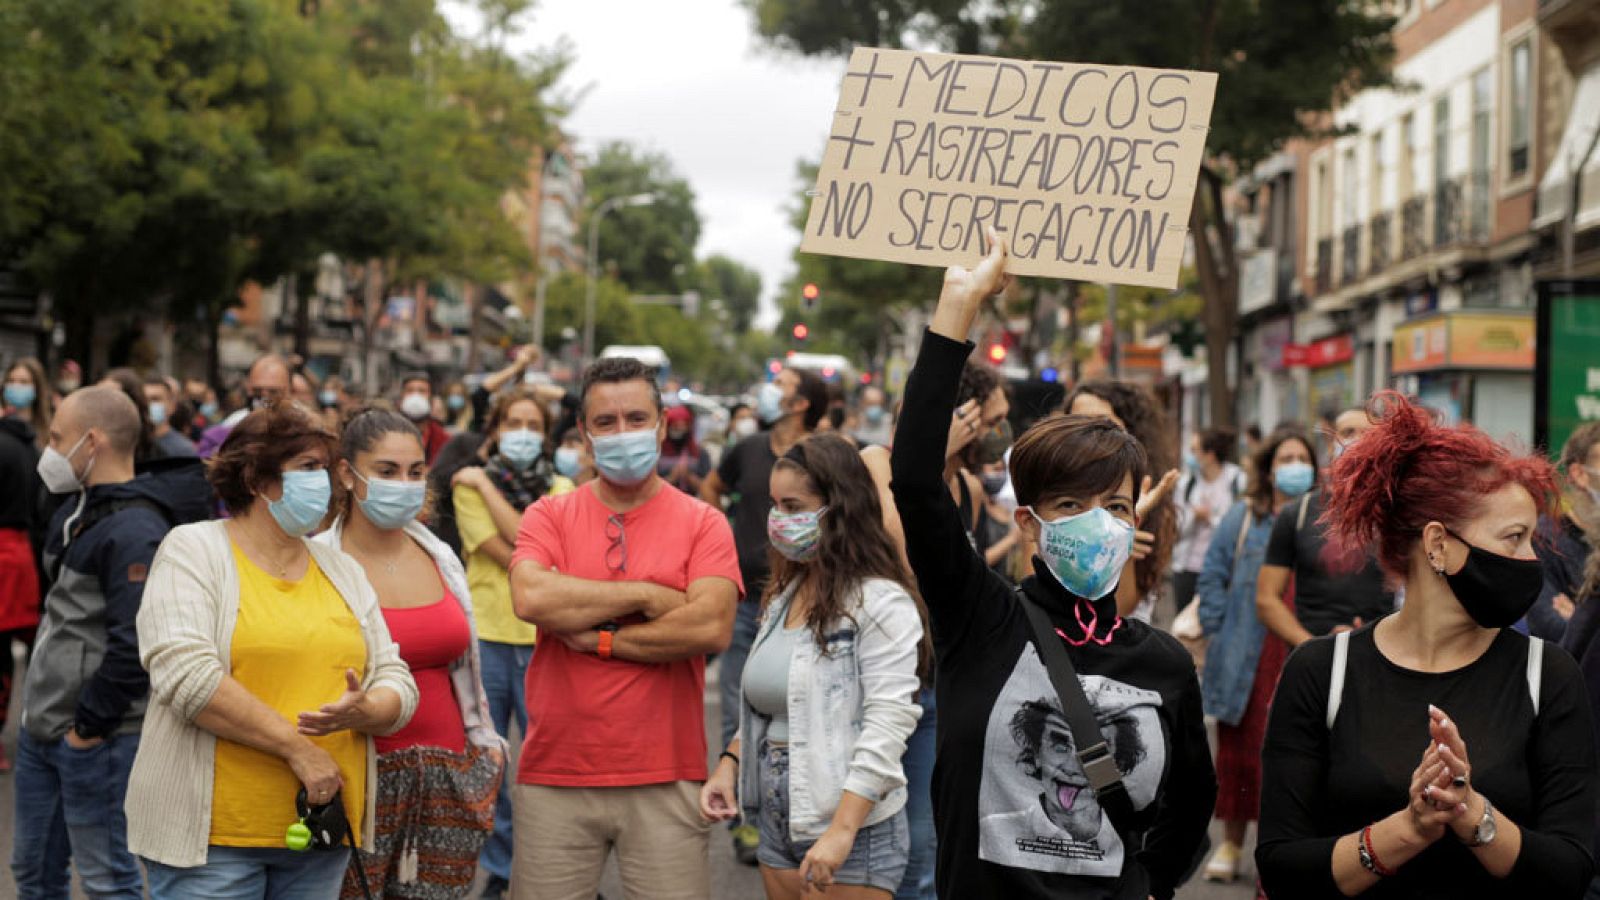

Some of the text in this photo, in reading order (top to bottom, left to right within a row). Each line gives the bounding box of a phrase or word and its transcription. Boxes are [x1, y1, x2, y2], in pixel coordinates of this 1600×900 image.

[897, 57, 1190, 133] MEDICOS
[880, 120, 1180, 200] RASTREADORES
[817, 181, 873, 239] NO
